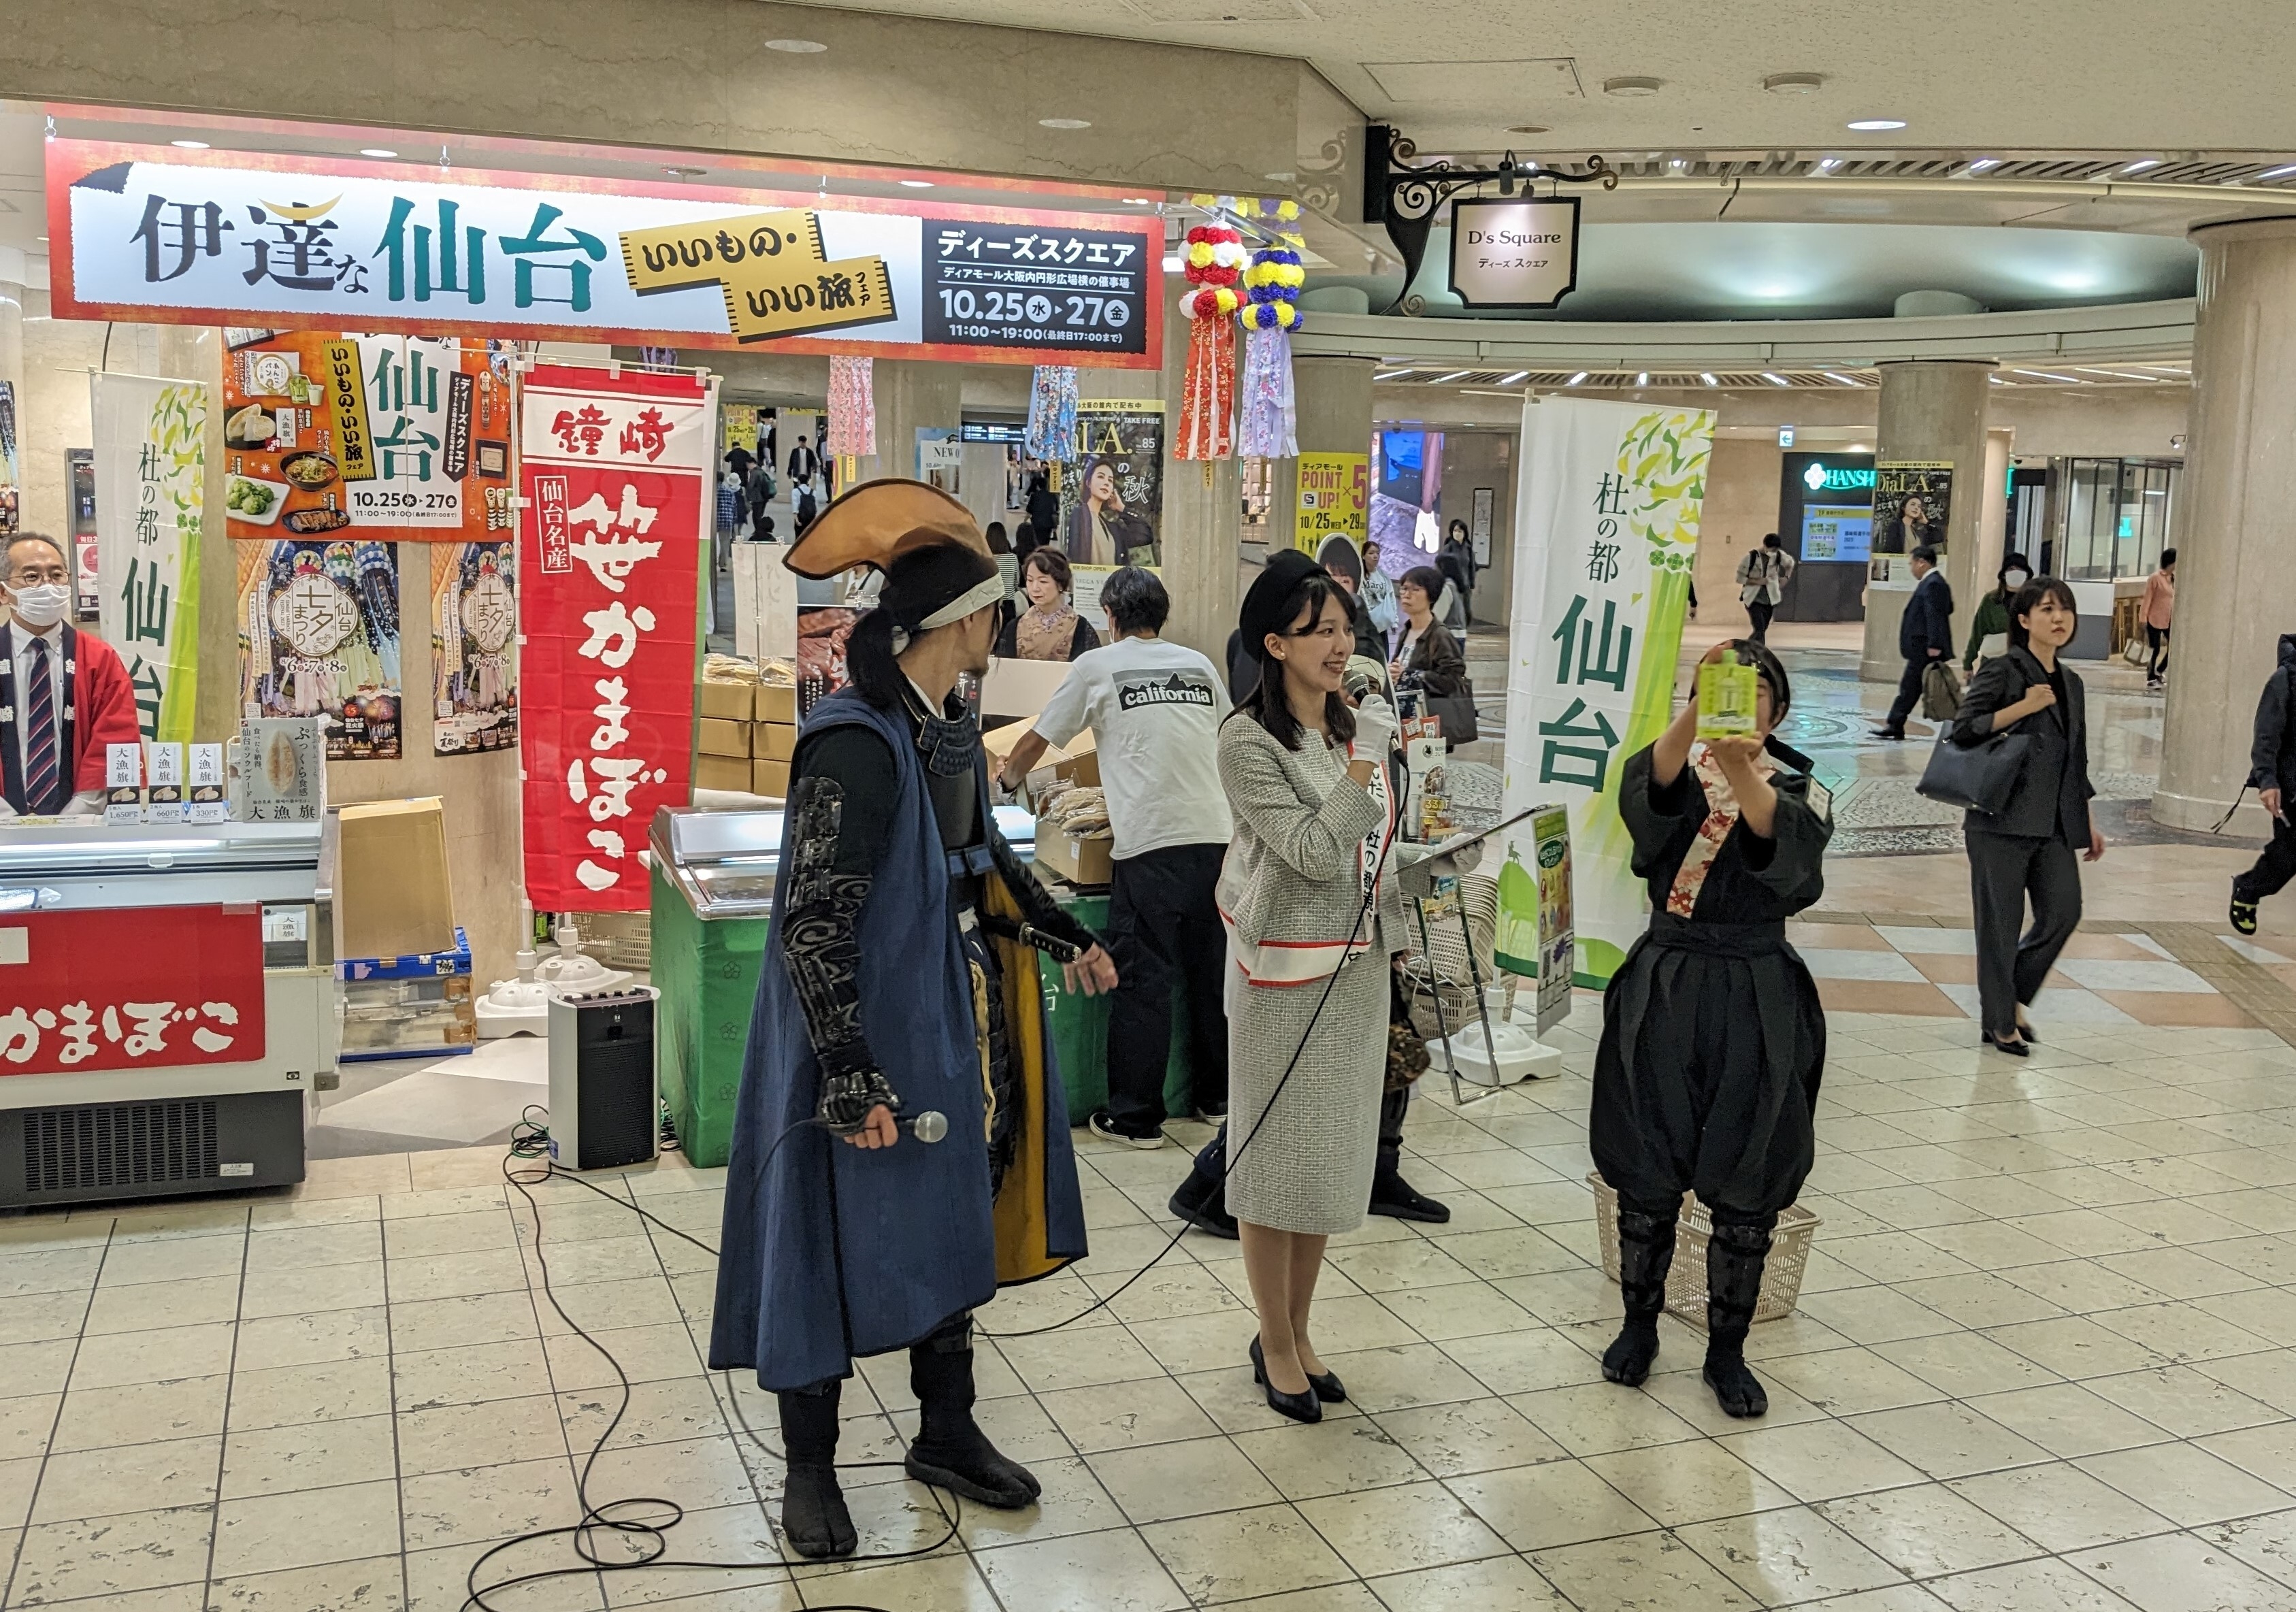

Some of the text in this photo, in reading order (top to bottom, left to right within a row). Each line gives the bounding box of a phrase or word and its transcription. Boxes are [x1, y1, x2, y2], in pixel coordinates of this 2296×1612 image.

[938, 229, 1136, 267] ディーズスクエア
[1468, 231, 1561, 247] D's Square
[944, 266, 1130, 289] ディアモール大阪内円形広場横の催事場
[368, 348, 441, 482] 仙台
[455, 378, 472, 473] ディーズスクエア
[551, 403, 674, 463] 鐘崎
[933, 446, 953, 458] NEW
[134, 442, 162, 546] 杜の都
[1301, 471, 1343, 489] POINT
[1318, 492, 1340, 510] UP!
[542, 480, 568, 570] 仙台名産
[1584, 472, 1630, 584] 杜の都
[293, 604, 310, 646] まつり
[295, 585, 333, 637] 七夕
[334, 601, 354, 632] 仙台
[480, 584, 504, 633] 七夕
[504, 598, 513, 627] 仙台
[567, 484, 668, 891] 笹かまぼこ
[1125, 685, 1211, 707] california
[1538, 593, 1634, 793] 仙台
[116, 747, 129, 783] 大漁旗
[158, 746, 171, 782] 大漁旗
[199, 747, 212, 782] 大漁旗
[242, 728, 252, 797] 仙台のソウルフード
[295, 727, 311, 797] ぷっくら食感
[247, 804, 316, 820] 大漁旗
[0, 1000, 239, 1064] かまぼこ
